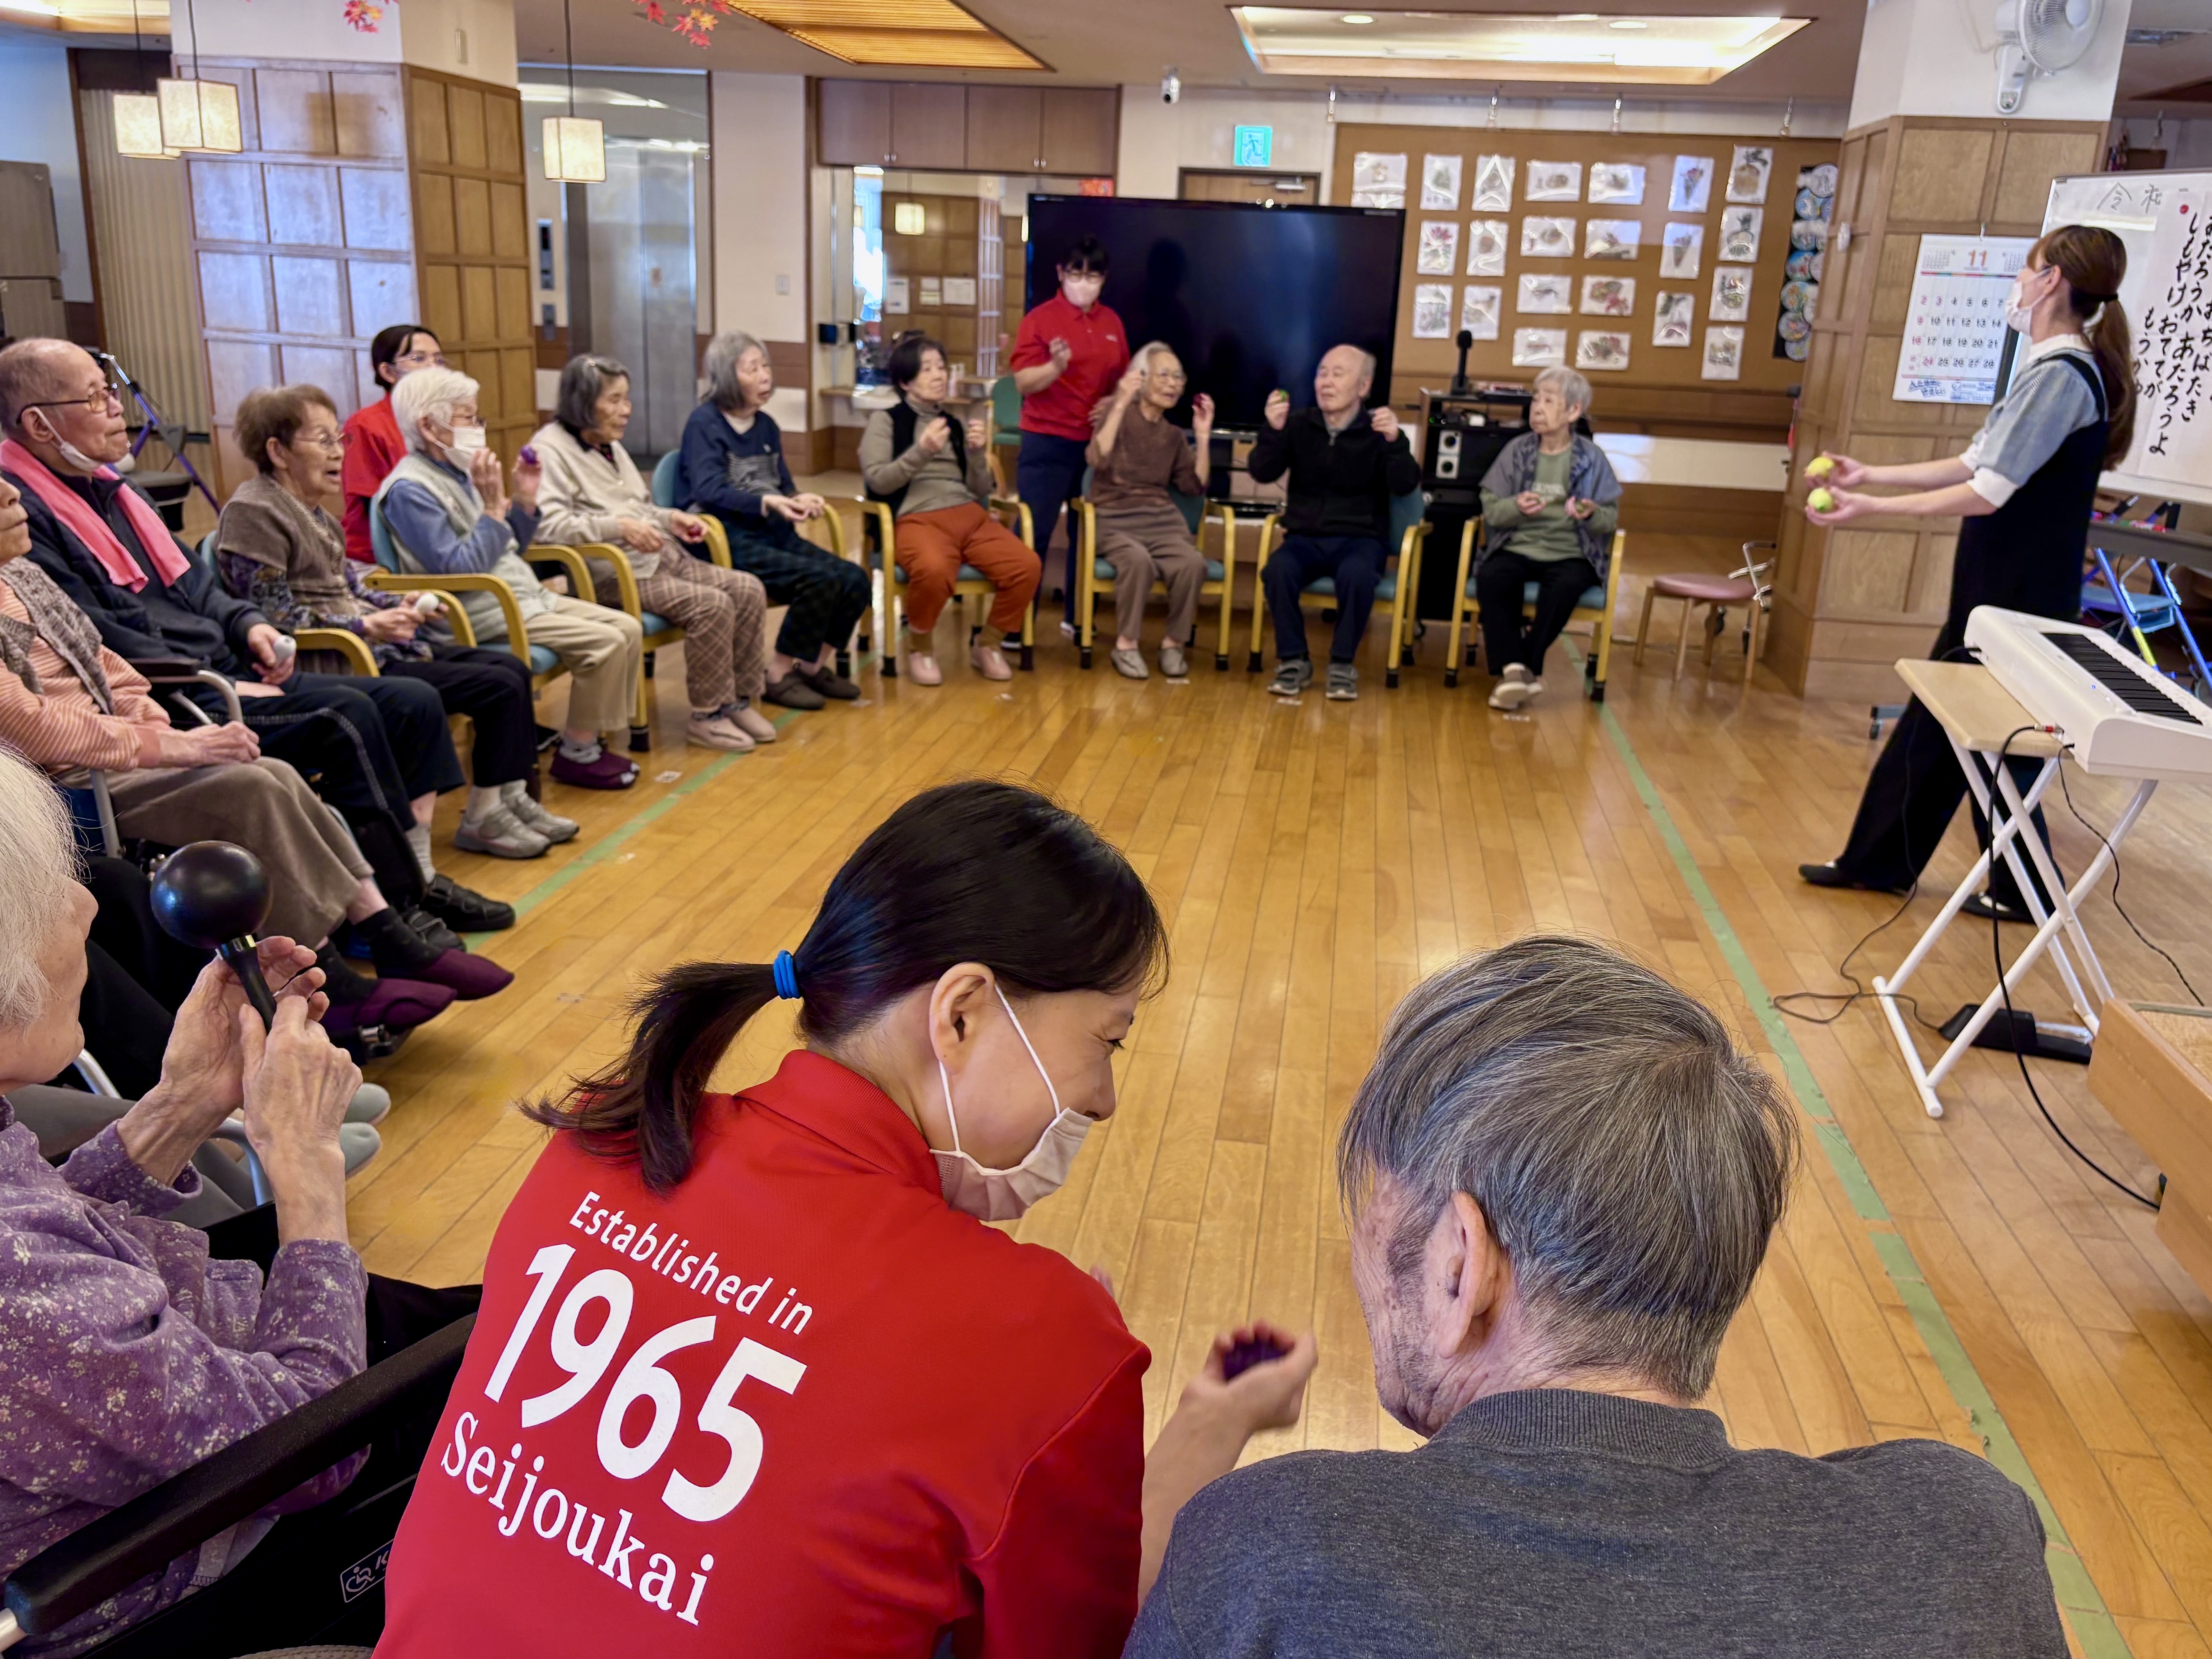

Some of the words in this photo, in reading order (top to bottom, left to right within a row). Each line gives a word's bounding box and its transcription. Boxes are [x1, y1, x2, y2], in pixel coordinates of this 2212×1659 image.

[2097, 181, 2189, 213] 令和
[1968, 249, 1987, 267] 11
[1920, 296, 1927, 305] 2
[1936, 296, 1943, 305] 3
[1951, 296, 1957, 305] 4
[1967, 297, 1973, 307] 5
[1982, 298, 1988, 307] 6
[1931, 316, 1941, 326] 10
[1947, 317, 1955, 326] 11
[1961, 317, 1971, 327] 12
[1977, 318, 1986, 328] 13
[1992, 319, 2001, 328] 14
[1912, 336, 1922, 345] 16
[1927, 336, 1937, 346] 17
[1943, 337, 1952, 346] 18
[1958, 338, 1967, 347] 19
[1972, 338, 1983, 348] 20
[1987, 339, 1998, 349] 21
[1938, 357, 1949, 367] 25
[1953, 358, 1964, 367] 26
[1968, 358, 1980, 368] 27
[1983, 359, 1995, 369] 28
[569, 1191, 774, 1315] Established
[767, 1288, 813, 1335] in
[484, 1243, 808, 1522] 1965
[440, 1411, 714, 1626] Seijoukai
